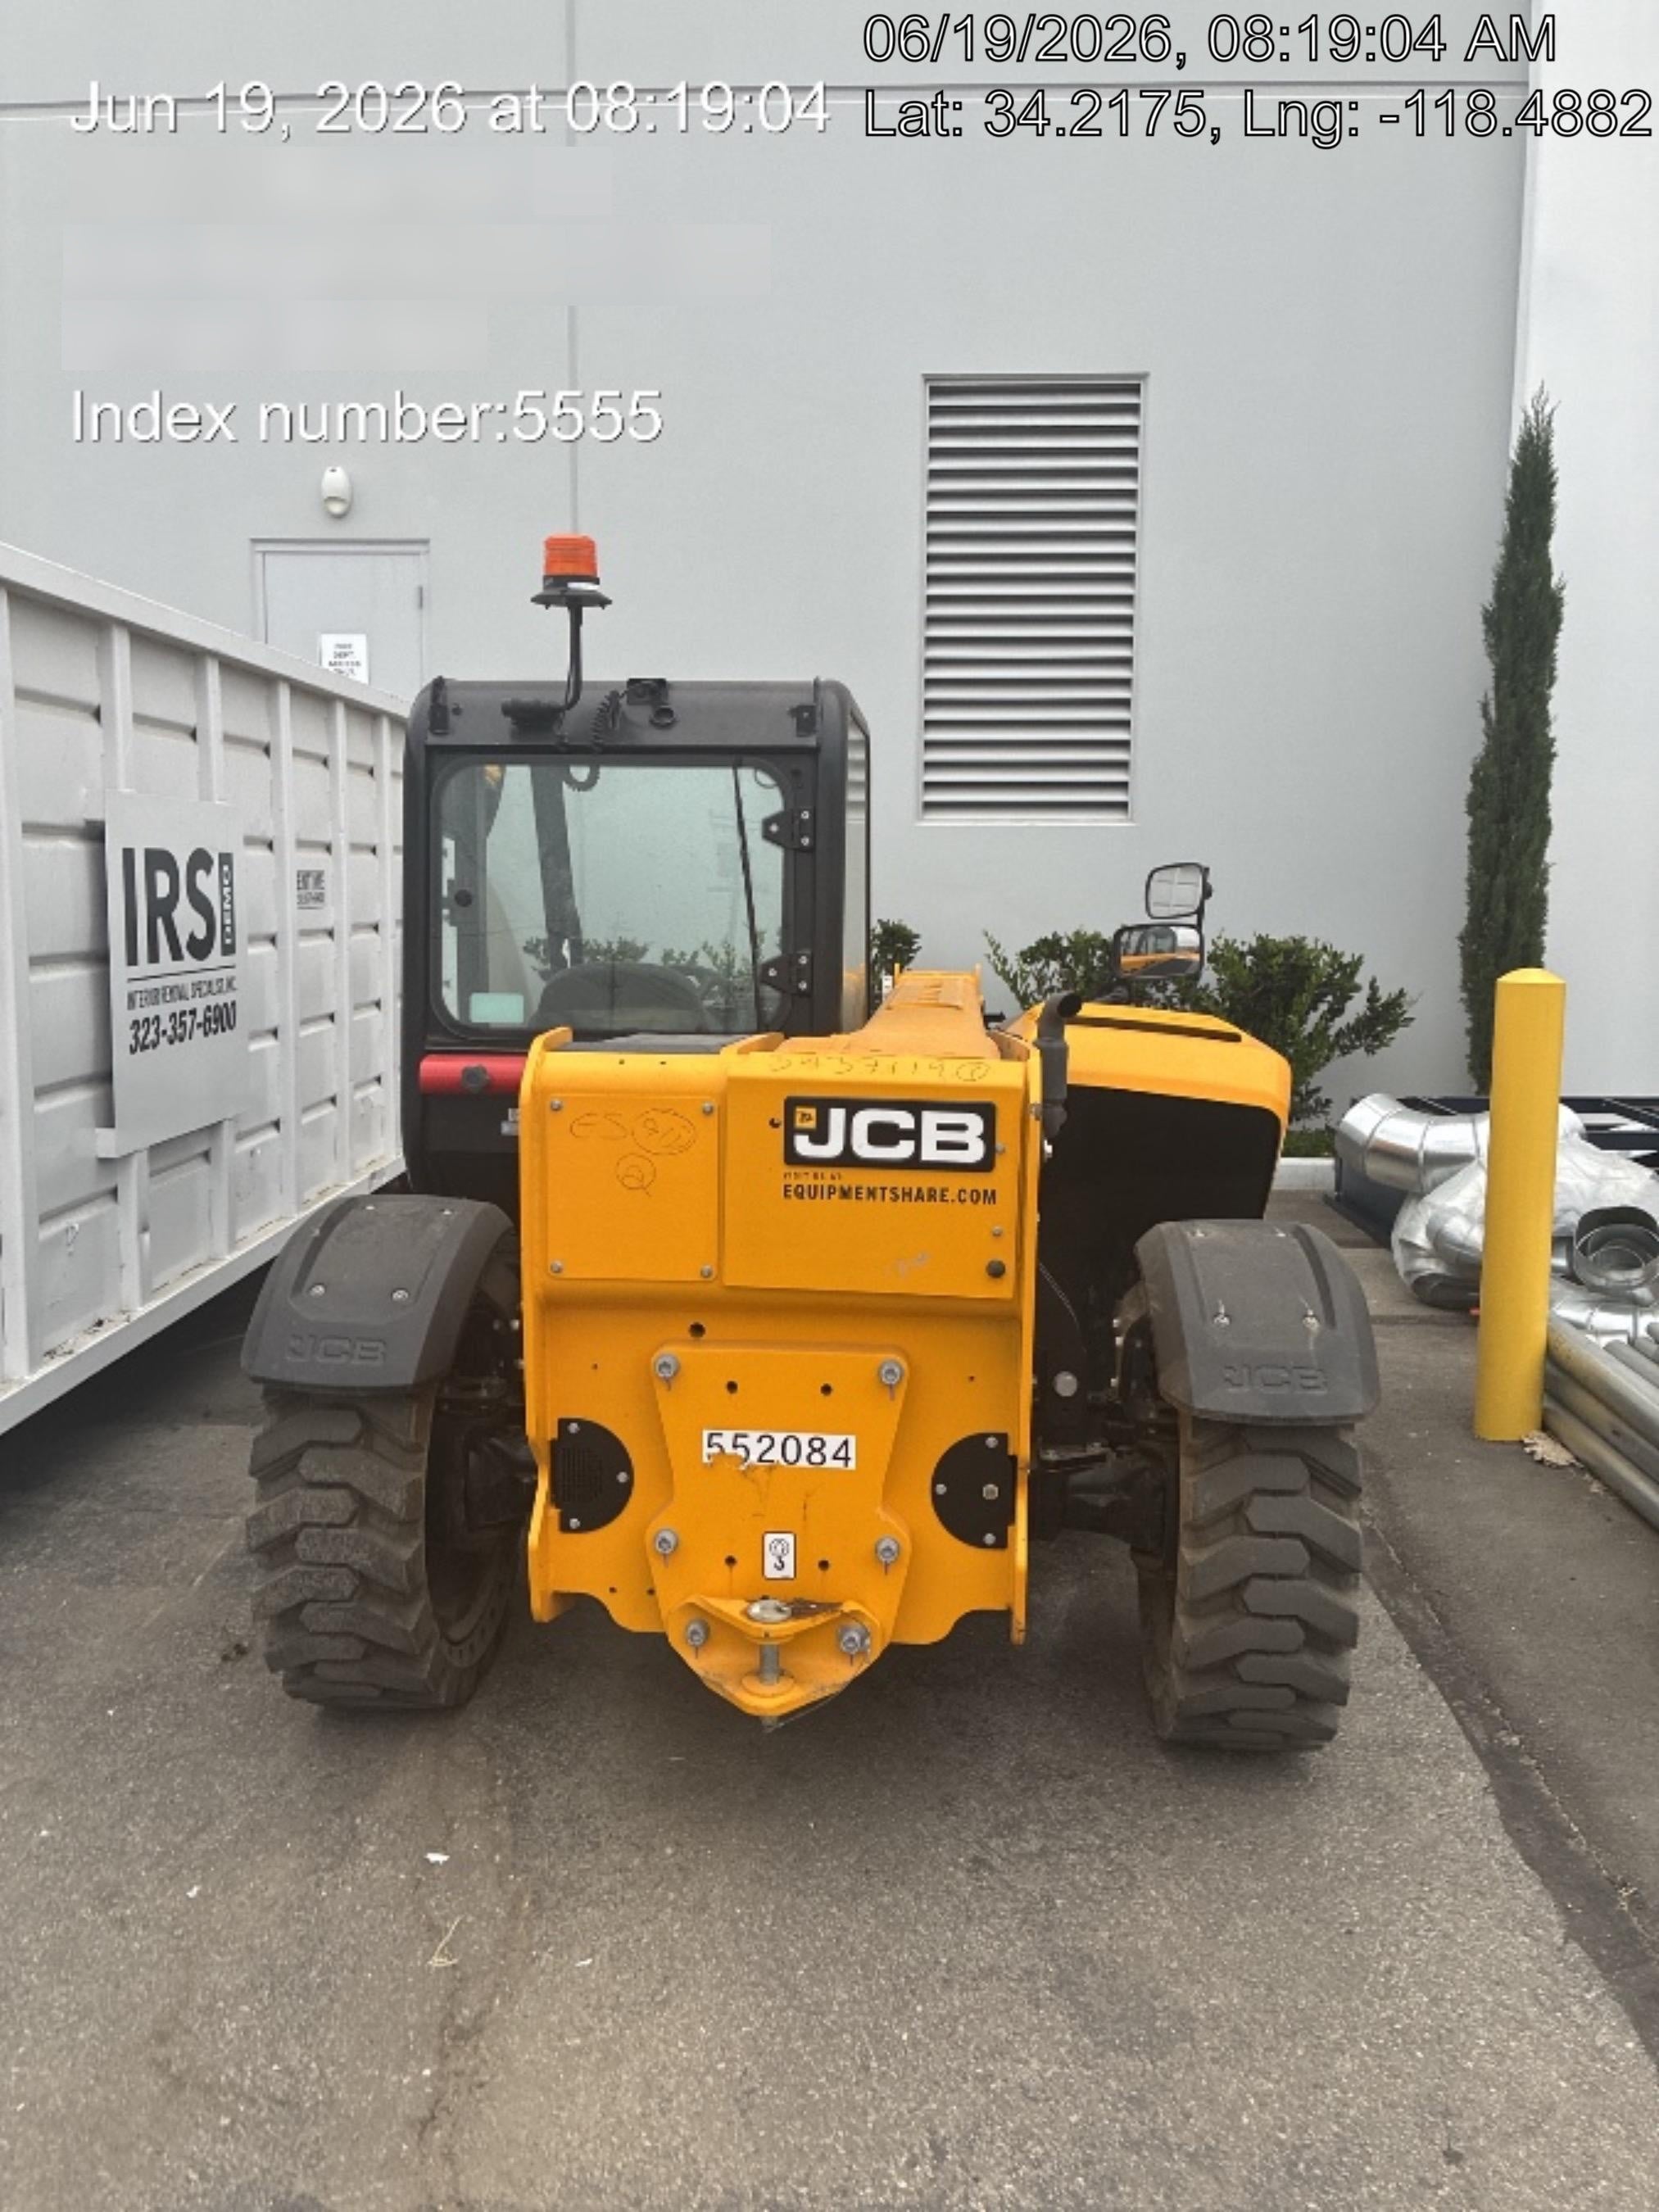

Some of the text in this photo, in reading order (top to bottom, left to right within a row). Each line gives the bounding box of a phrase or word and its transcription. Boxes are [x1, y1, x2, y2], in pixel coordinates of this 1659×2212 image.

[122, 847, 216, 967] IRS
[129, 1000, 237, 1055] 323-357-6900
[793, 1108, 986, 1163] JCB
[783, 1184, 997, 1205] EQUIPMENTSHARE.COM
[285, 1334, 388, 1365] JCB
[1223, 1363, 1329, 1394] JCB
[706, 1432, 853, 1469] 552084
